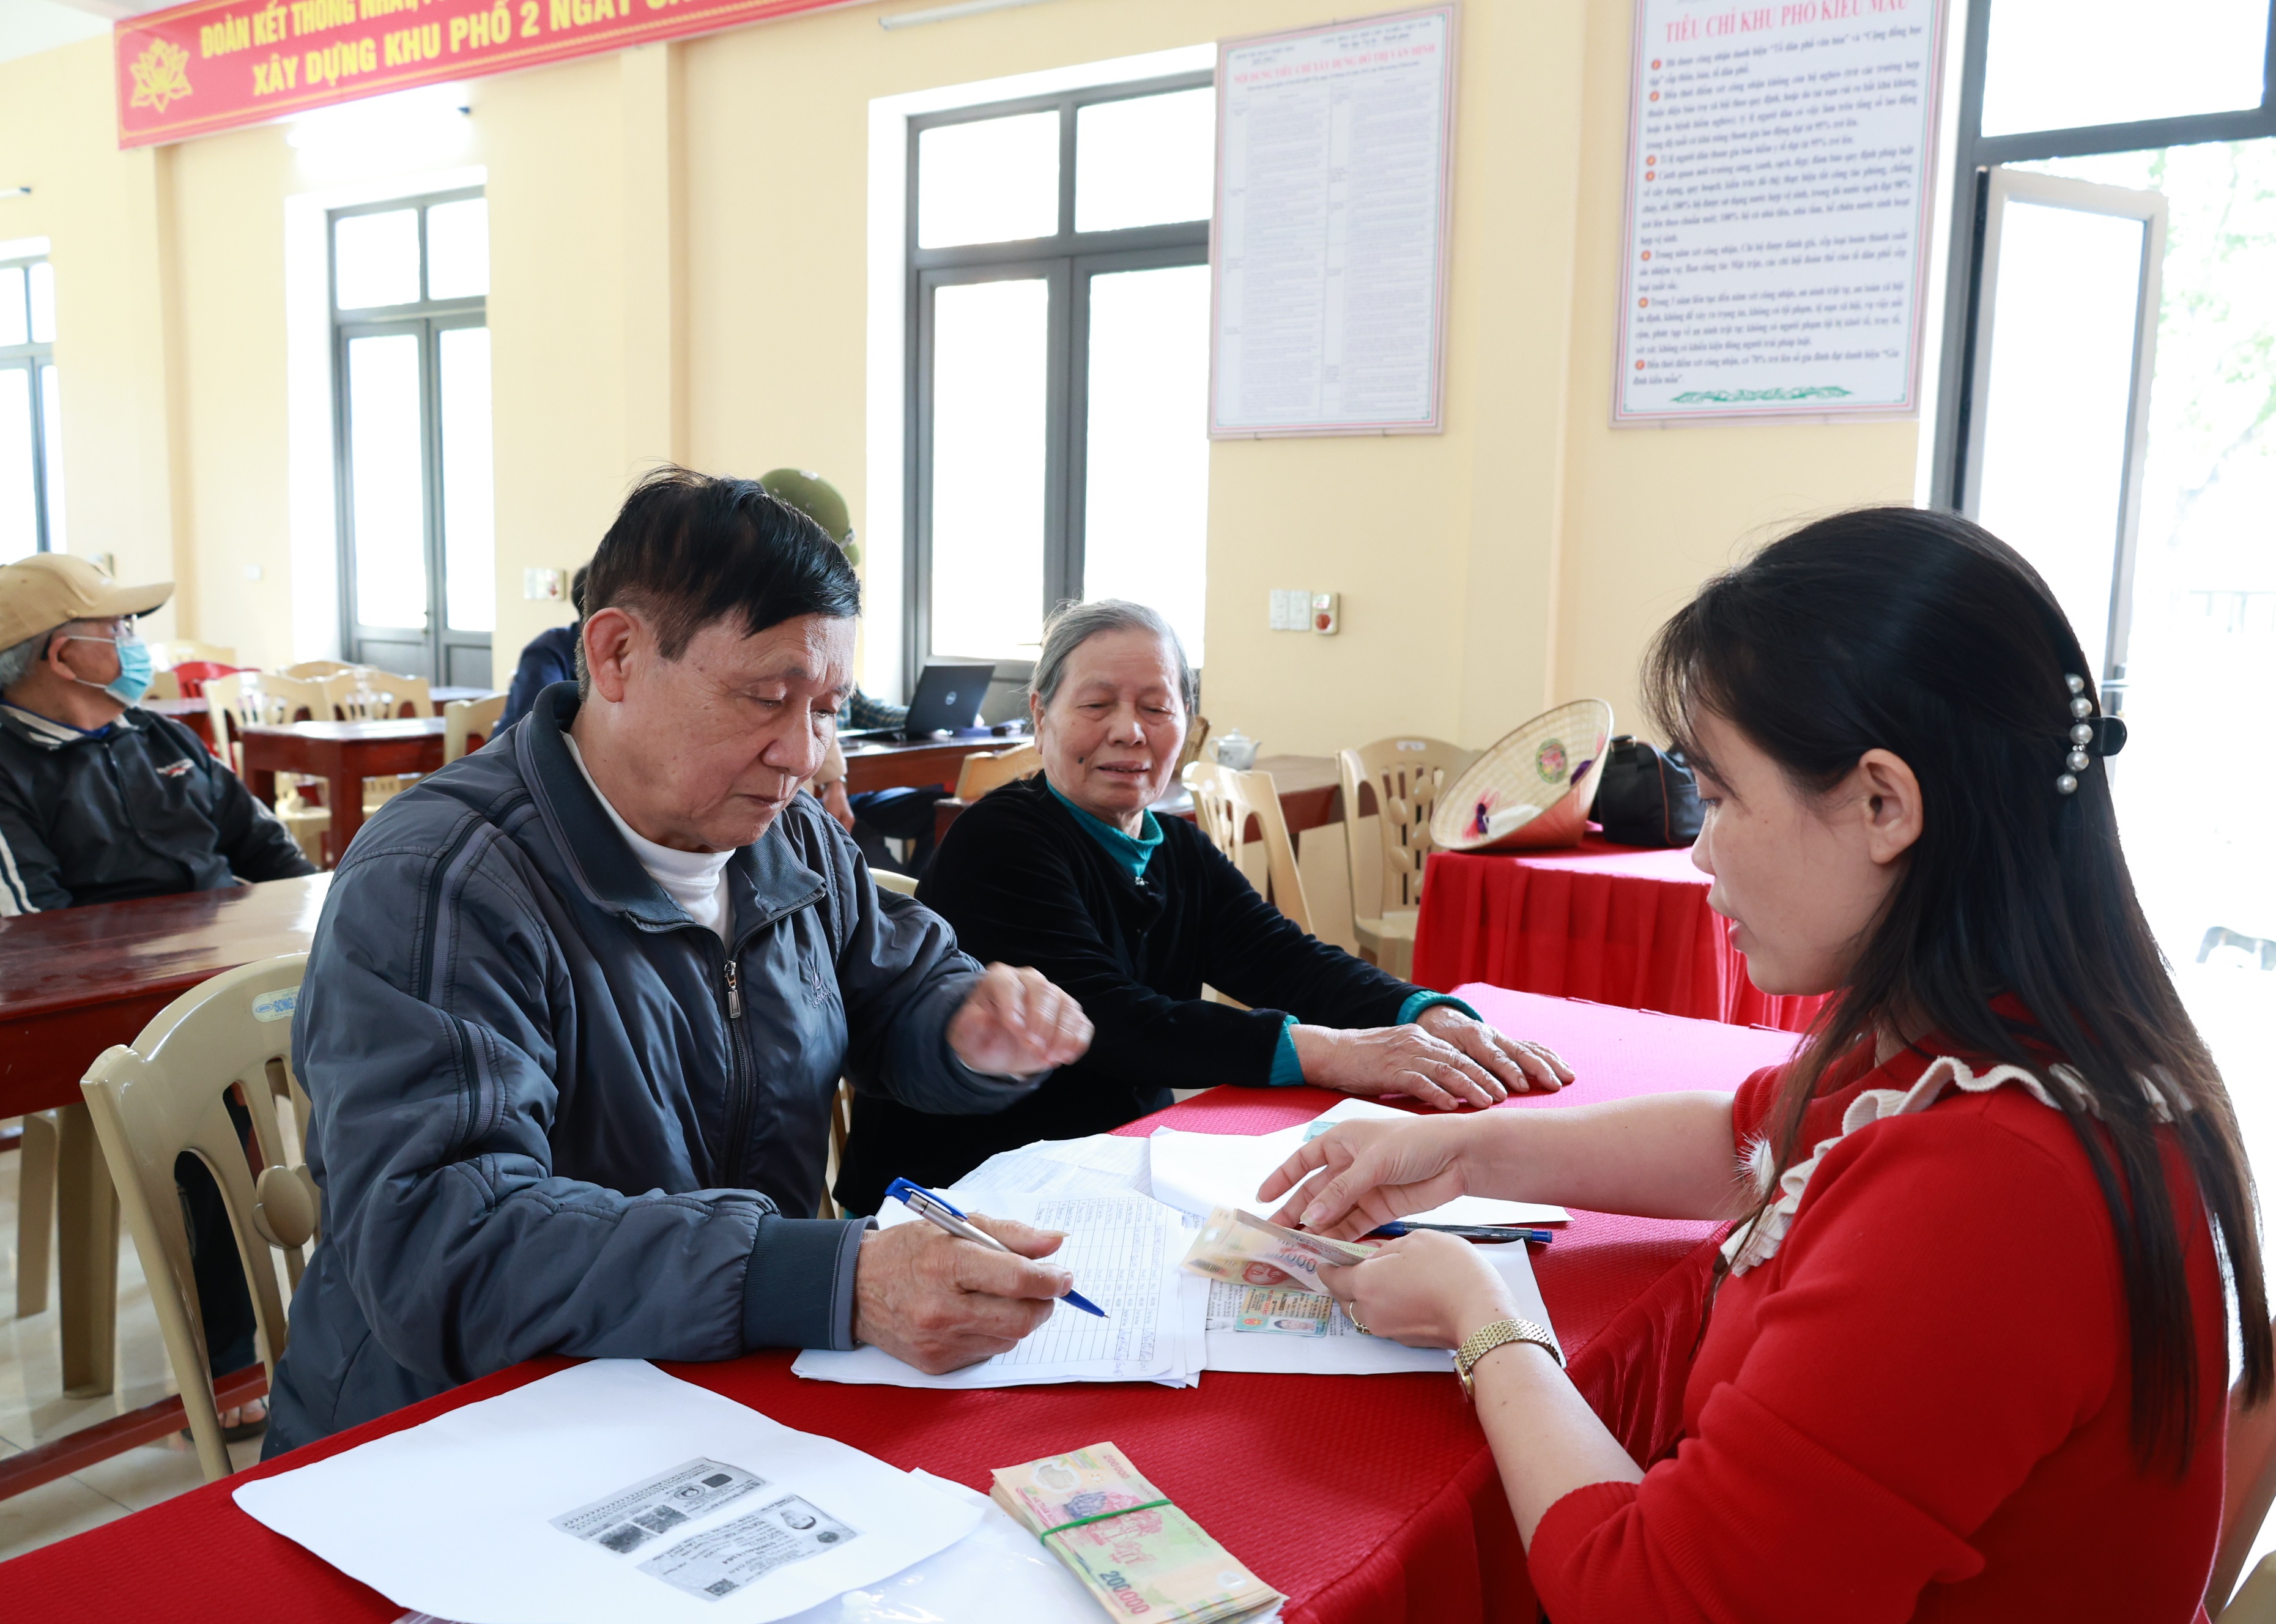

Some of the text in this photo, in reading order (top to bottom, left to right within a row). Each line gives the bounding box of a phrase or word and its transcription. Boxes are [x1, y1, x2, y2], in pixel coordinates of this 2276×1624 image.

[200, 12, 250, 58] ĐOÀN
[253, 0, 287, 46] KẾT
[1740, 5, 1775, 32] KHU
[253, 53, 299, 96] XÂY
[306, 39, 377, 86] DỰNG
[385, 23, 442, 67] KHU
[450, 2, 511, 53] PHỐ
[520, 1, 540, 38] 2
